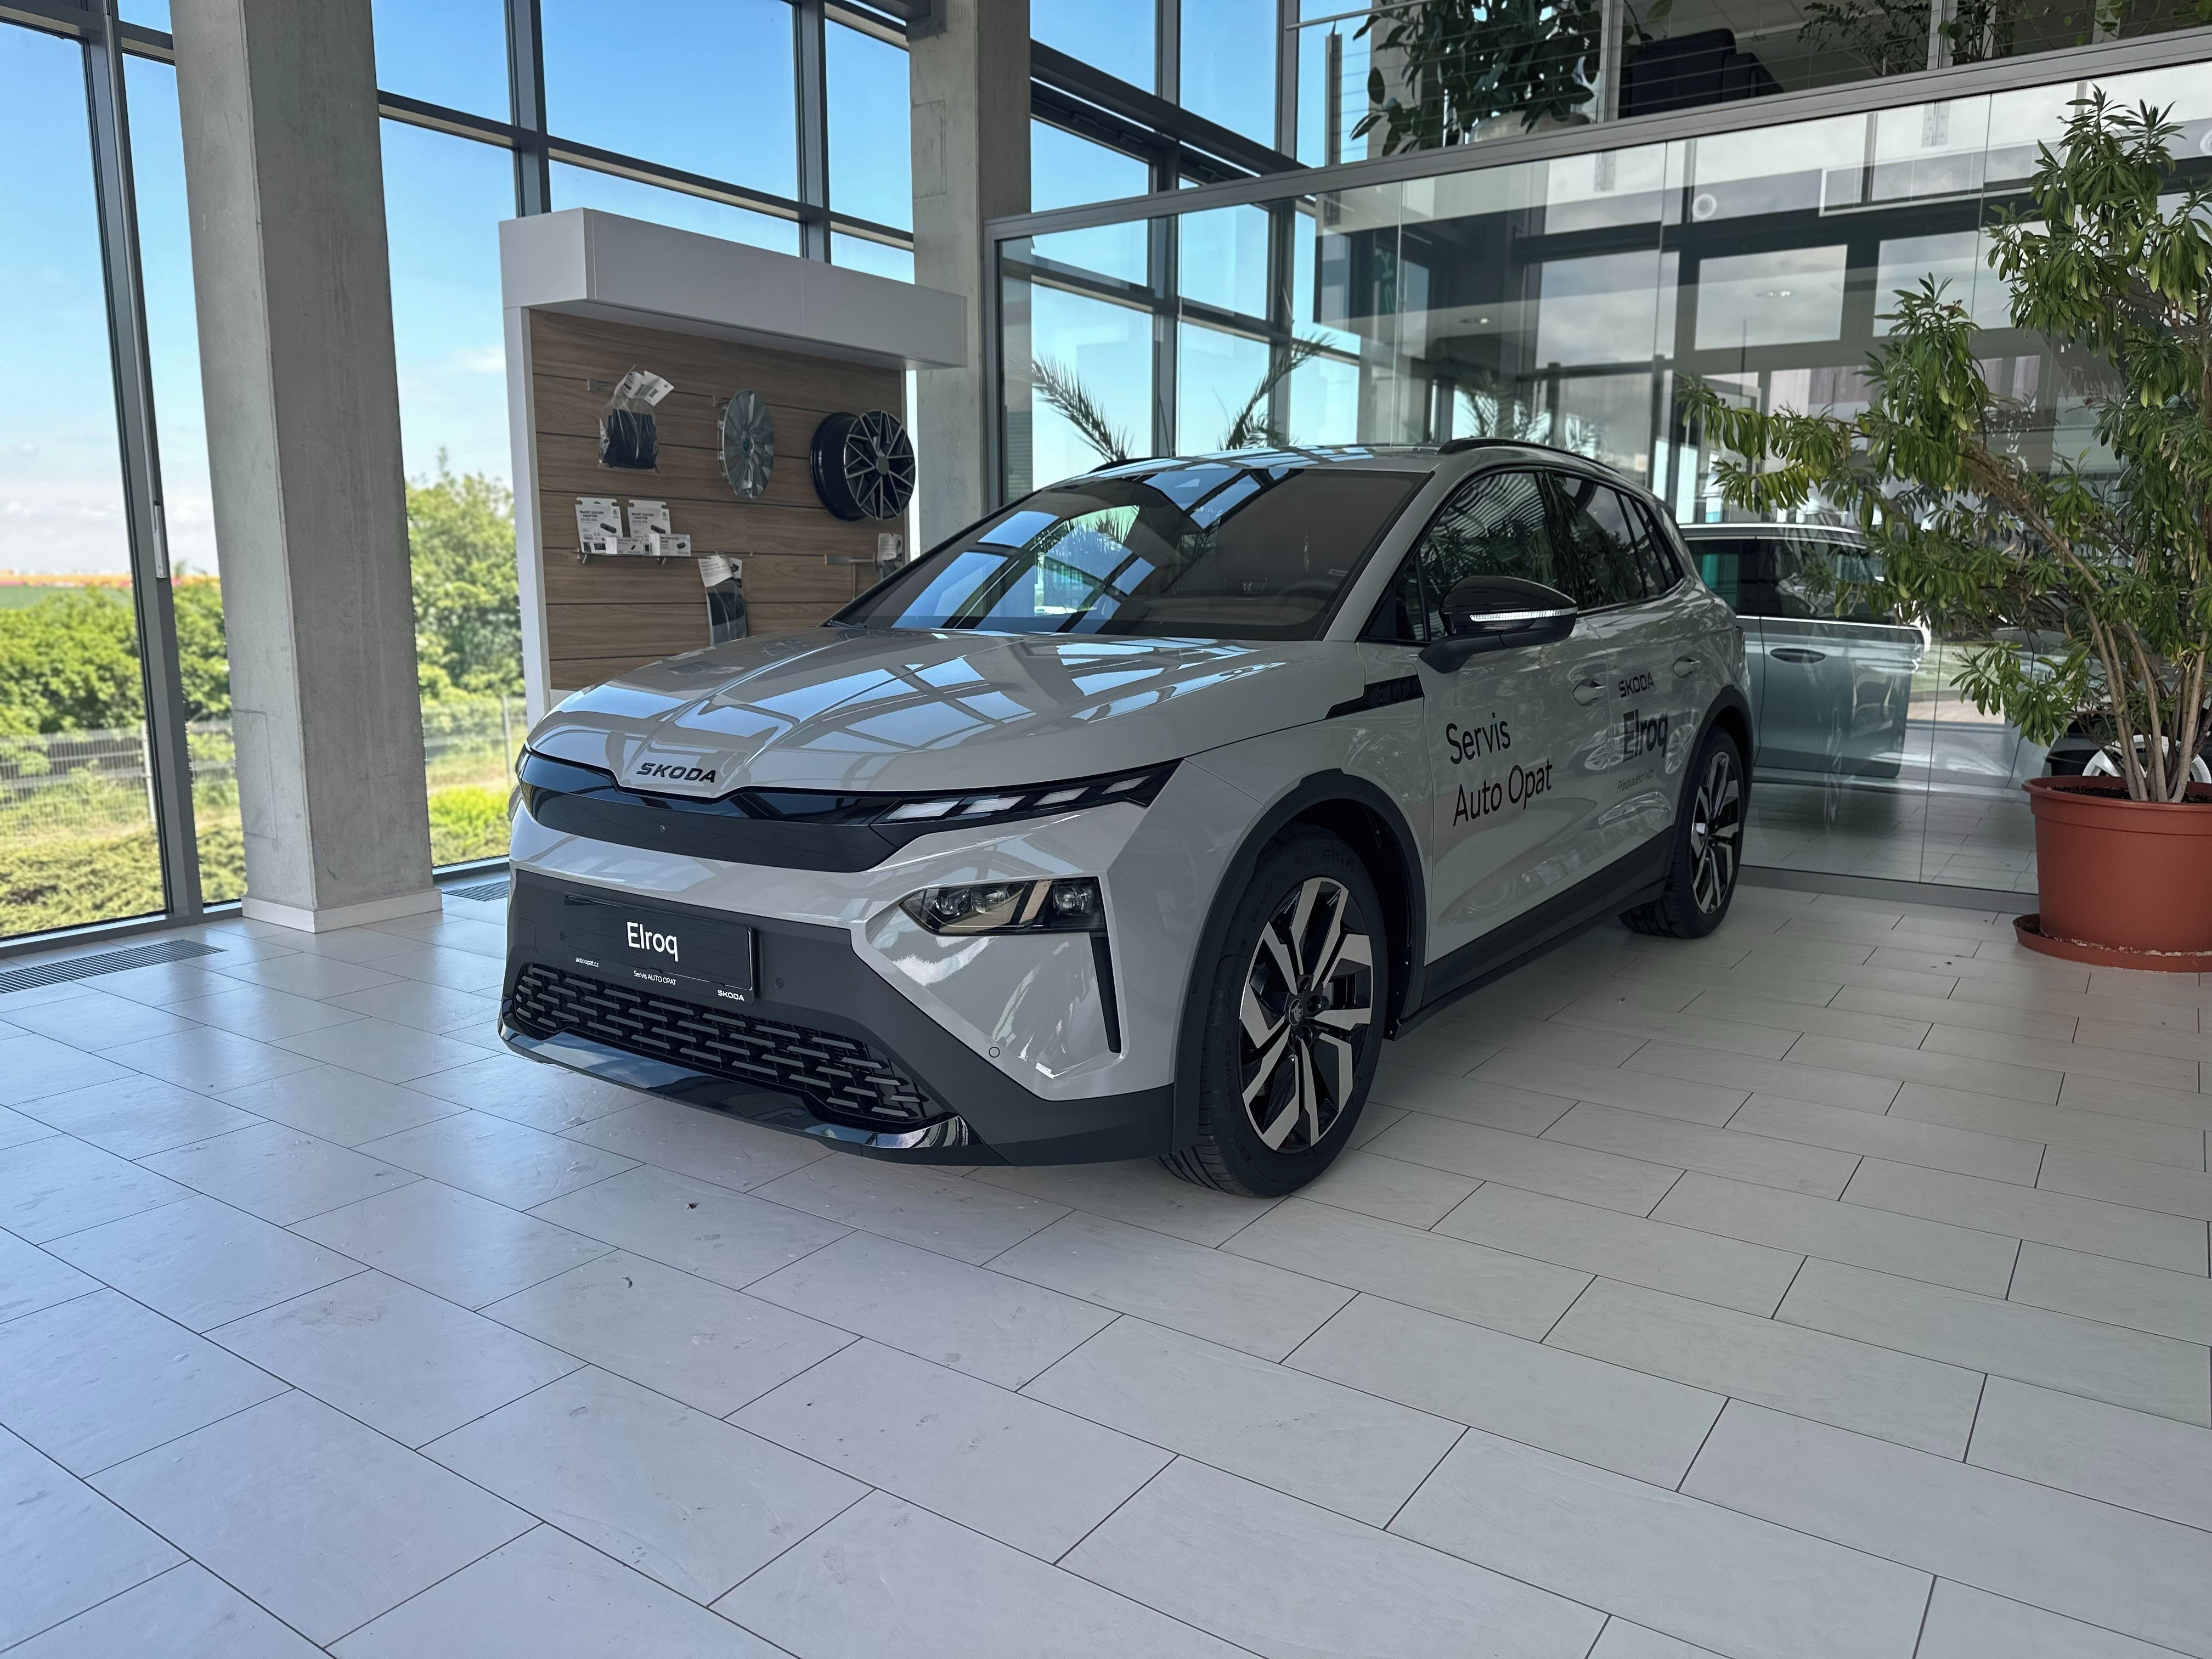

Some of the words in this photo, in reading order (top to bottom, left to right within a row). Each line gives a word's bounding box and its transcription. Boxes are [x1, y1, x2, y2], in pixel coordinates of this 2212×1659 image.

[1446, 712, 1510, 765] Servis
[1622, 709, 1668, 763] Elroq
[1452, 778, 1503, 827] Auto
[1508, 758, 1553, 810] Opat
[627, 922, 679, 962] Elroq
[633, 970, 647, 980] Servis
[647, 974, 663, 983] AUTO
[663, 977, 677, 986] OPAT
